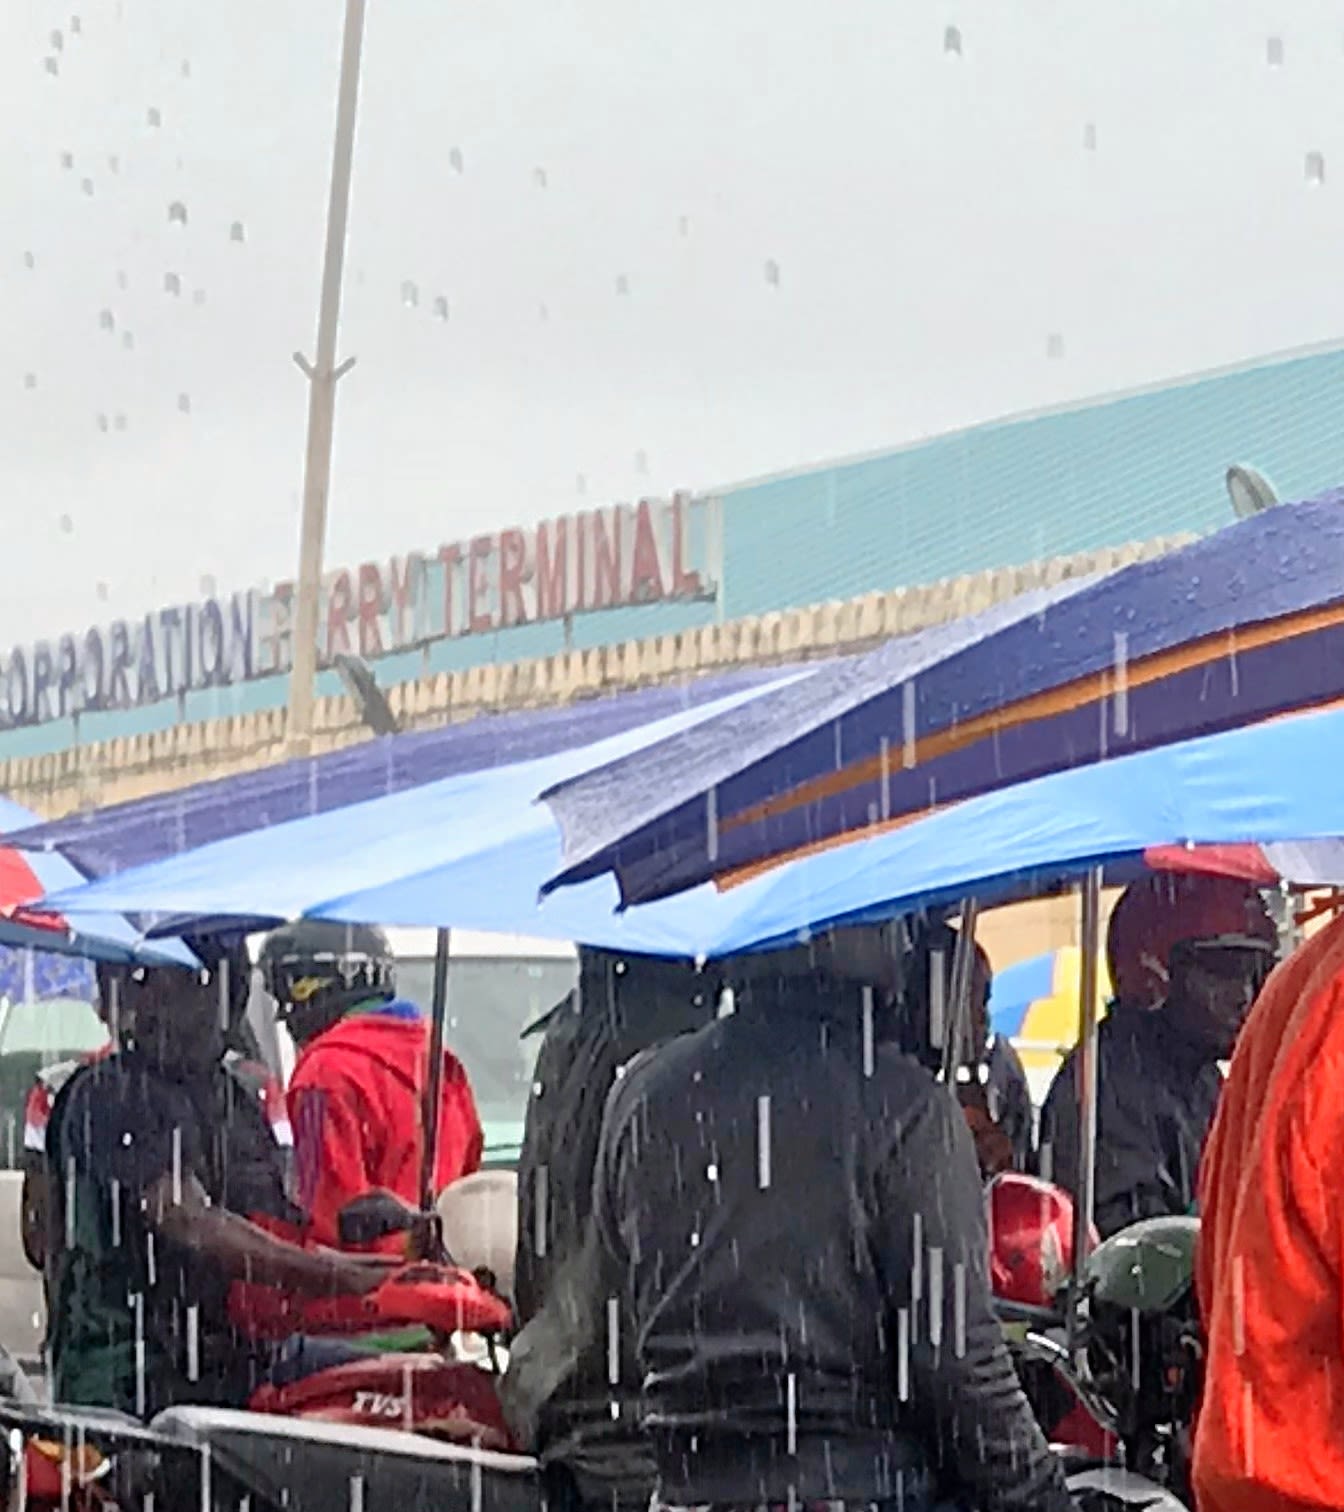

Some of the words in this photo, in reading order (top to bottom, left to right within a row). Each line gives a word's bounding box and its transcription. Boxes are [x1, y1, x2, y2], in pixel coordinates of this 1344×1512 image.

[0, 588, 253, 728] ORPORATION
[270, 553, 416, 670] FRRY
[438, 491, 706, 640] TERMINAL
[351, 1392, 402, 1417] TVS
